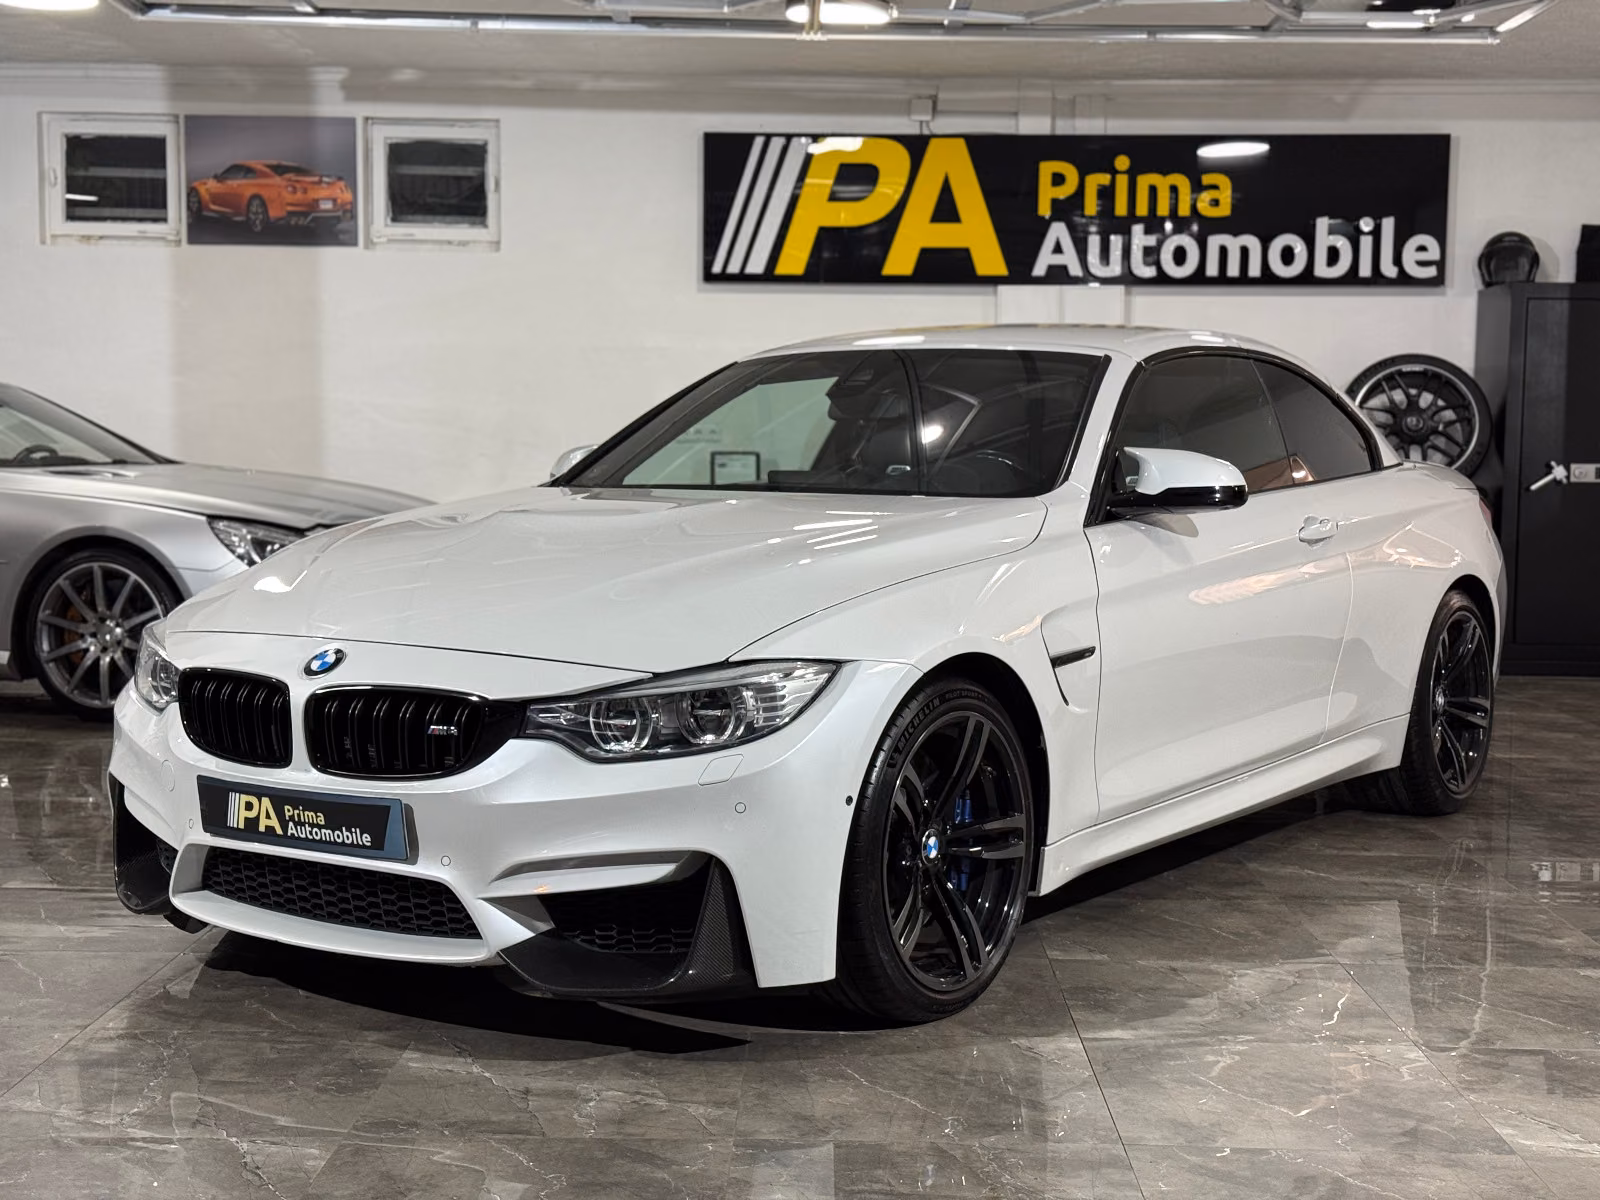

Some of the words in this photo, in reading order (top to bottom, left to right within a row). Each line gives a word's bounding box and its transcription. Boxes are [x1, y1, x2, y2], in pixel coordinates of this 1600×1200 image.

[775, 137, 1009, 277] PA
[1037, 155, 1233, 218] Prima
[1031, 216, 1441, 279] Automobile
[896, 697, 940, 751] MICHELIN
[238, 794, 284, 836] PA
[284, 805, 326, 825] Prima
[287, 822, 372, 847] Automobile
